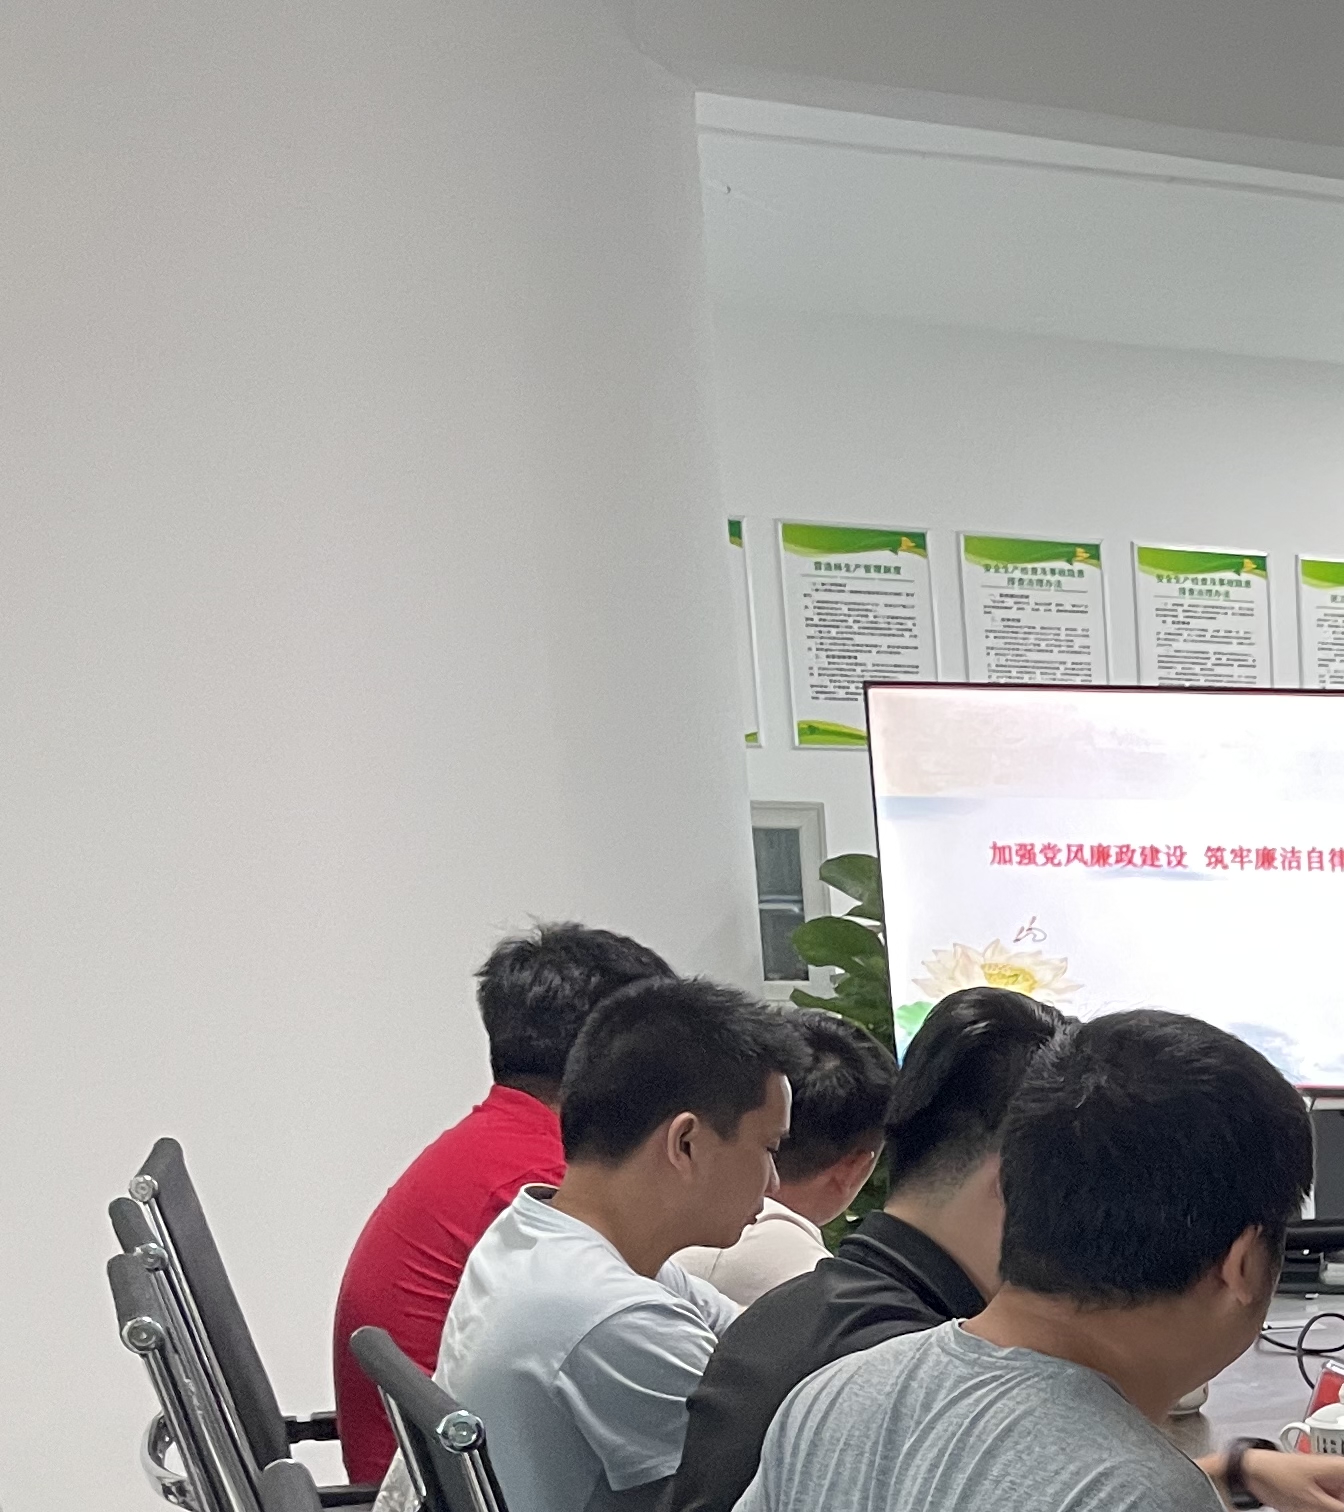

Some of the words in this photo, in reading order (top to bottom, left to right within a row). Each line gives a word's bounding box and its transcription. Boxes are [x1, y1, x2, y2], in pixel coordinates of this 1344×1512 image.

[989, 840, 1188, 869] 加强党风廉政建设
